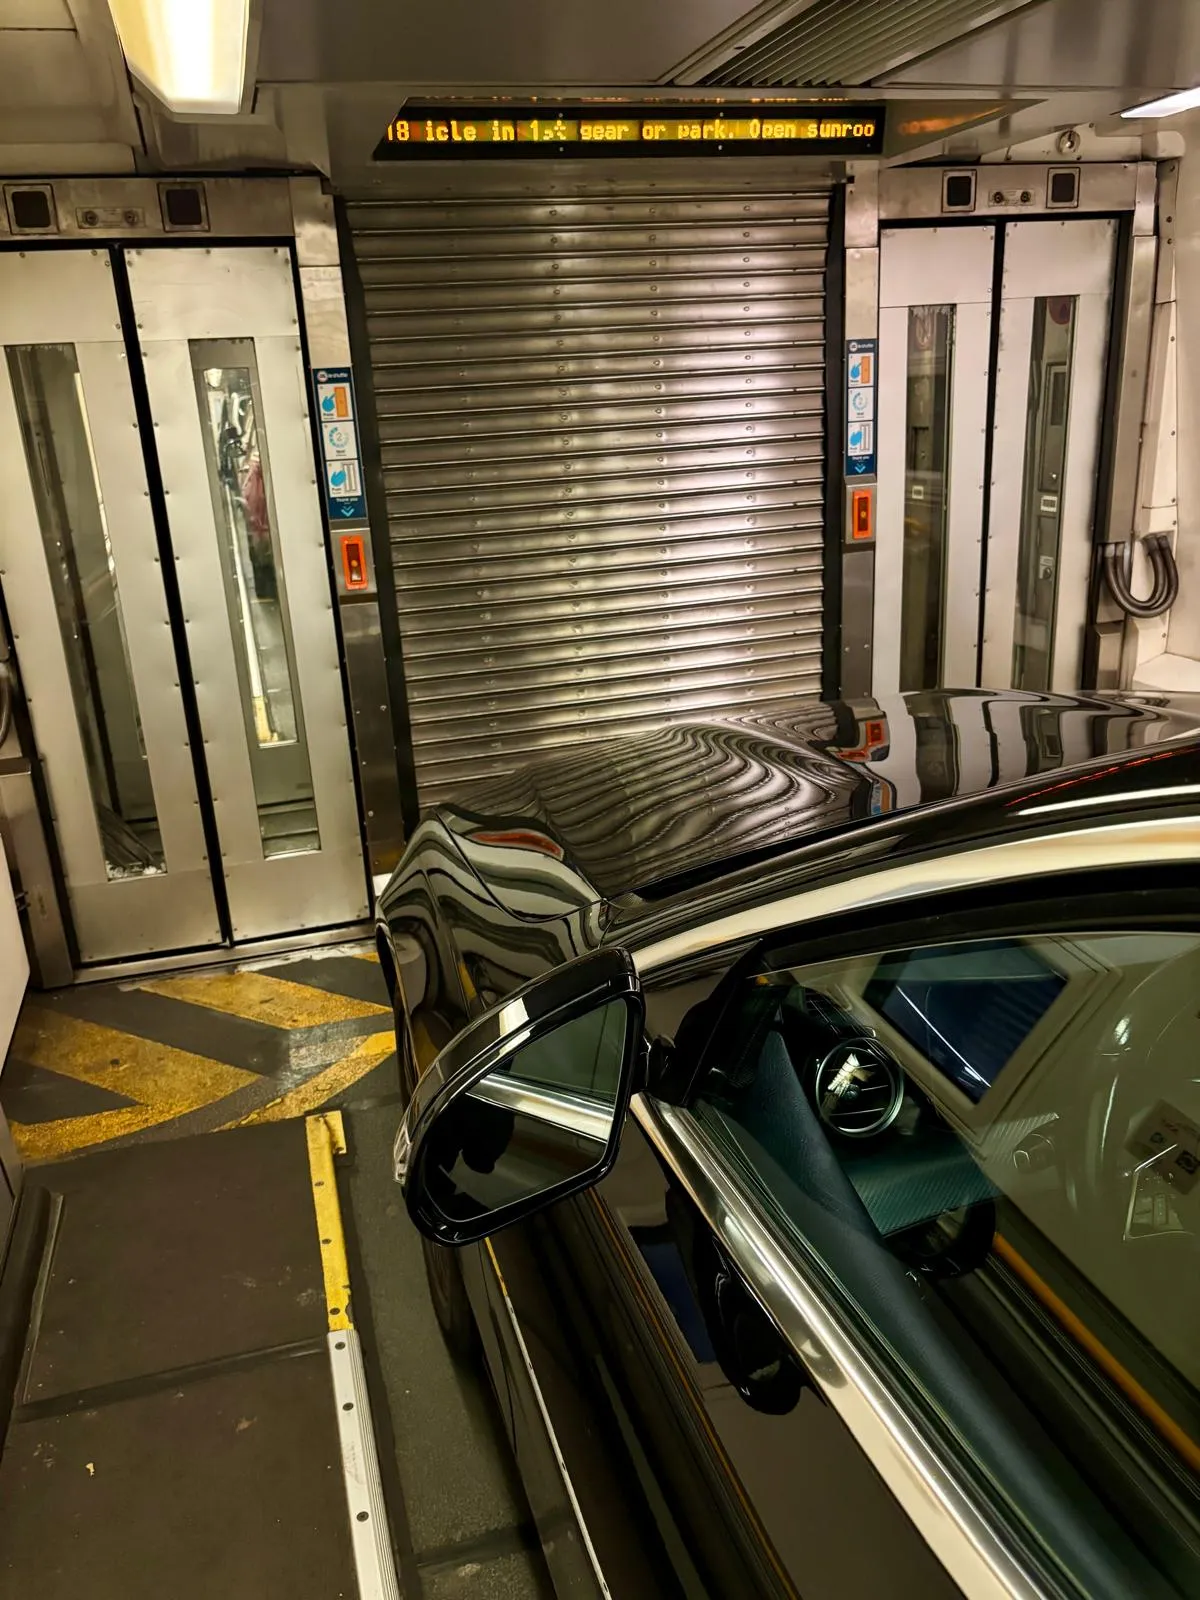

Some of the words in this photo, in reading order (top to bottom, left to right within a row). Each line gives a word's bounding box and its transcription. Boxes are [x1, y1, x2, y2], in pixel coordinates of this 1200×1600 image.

[425, 120, 477, 141] icle
[491, 120, 515, 141] in
[580, 124, 630, 140] gear
[642, 124, 667, 140] or
[748, 118, 796, 139] Open
[806, 119, 876, 138] sunroo
